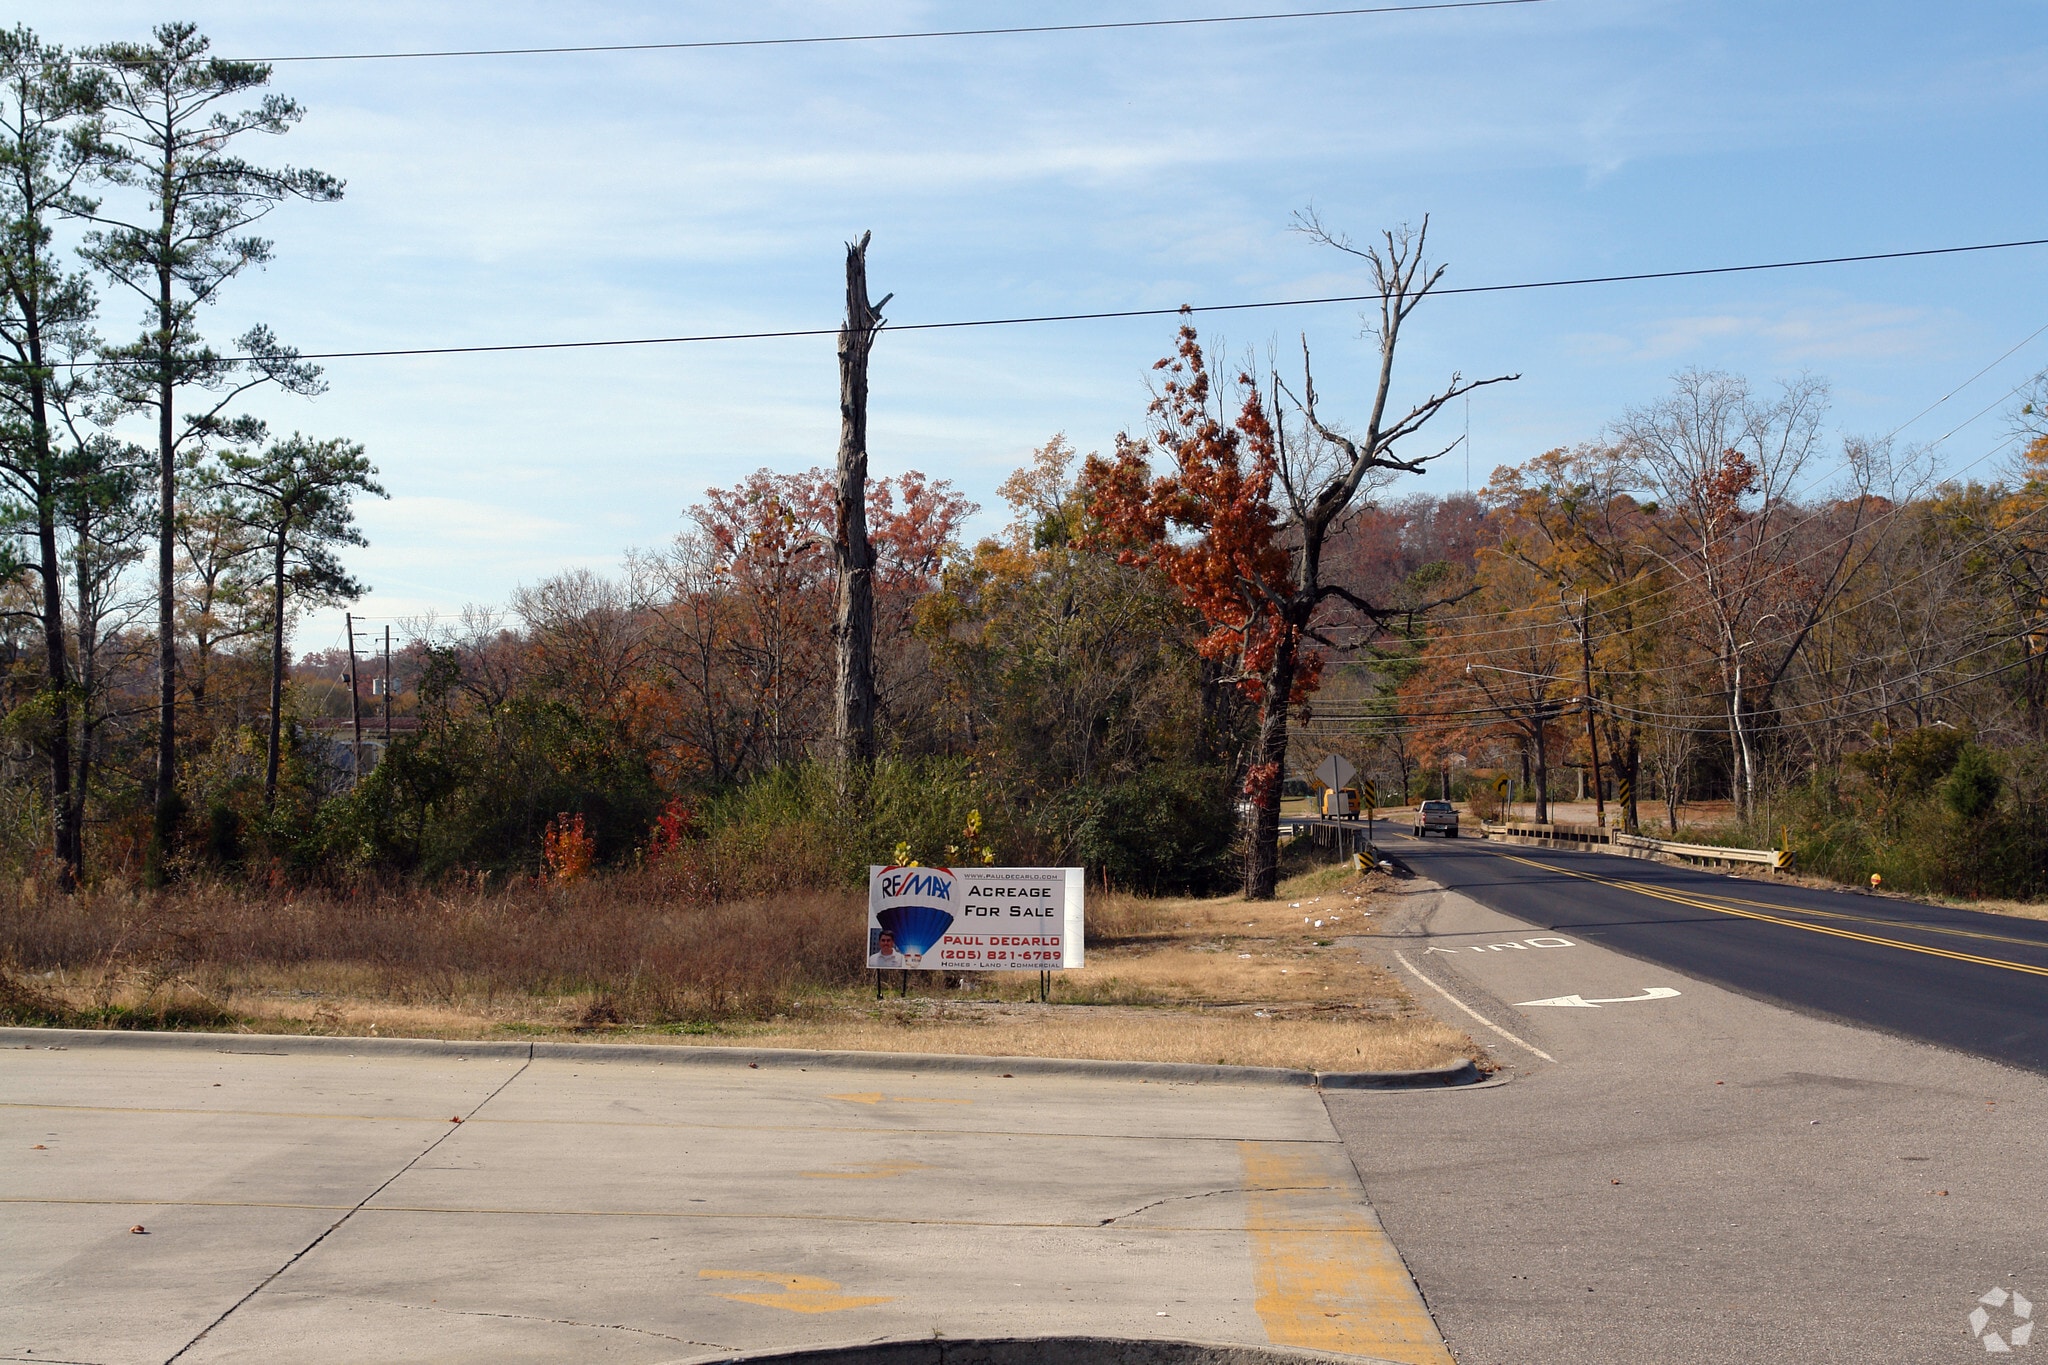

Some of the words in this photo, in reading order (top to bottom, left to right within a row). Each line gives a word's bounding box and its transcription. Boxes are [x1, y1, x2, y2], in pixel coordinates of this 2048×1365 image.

[882, 872, 952, 901] RE/MAX
[968, 885, 1052, 897] ACREAGE
[965, 905, 1000, 917] FOR
[1009, 905, 1054, 917] SALE
[943, 936, 984, 945] PAUL
[990, 937, 1060, 946] DECARLO
[1423, 937, 1576, 954] ONLY
[941, 950, 981, 960] (205)
[987, 951, 1061, 960] 821-6789
